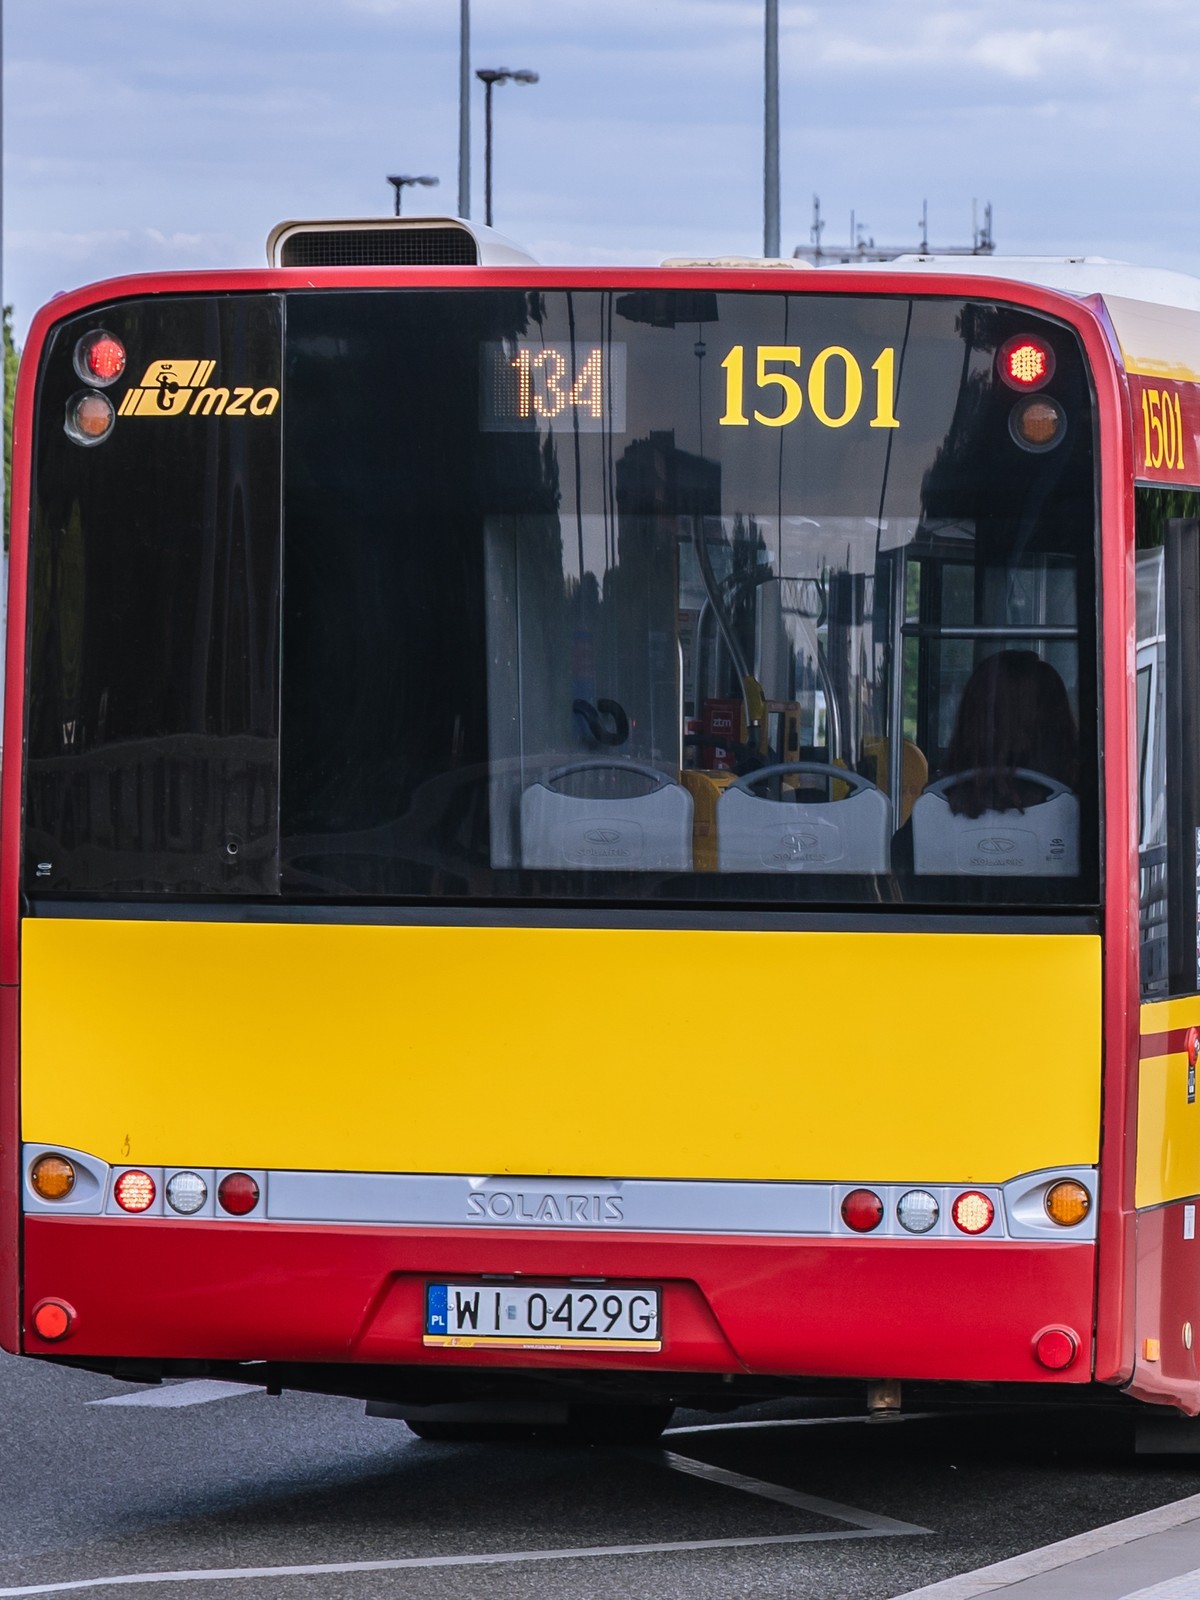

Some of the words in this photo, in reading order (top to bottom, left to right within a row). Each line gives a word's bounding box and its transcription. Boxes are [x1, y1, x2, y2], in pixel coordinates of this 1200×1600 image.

[190, 386, 280, 416] mza
[511, 348, 603, 418] 134
[719, 345, 900, 428] 1501
[1142, 388, 1186, 470] 1501
[712, 718, 732, 728] ztm
[466, 1192, 625, 1222] SOLARIS
[431, 1315, 445, 1327] PL
[455, 1291, 501, 1331] WI
[527, 1293, 652, 1334] 0429G
